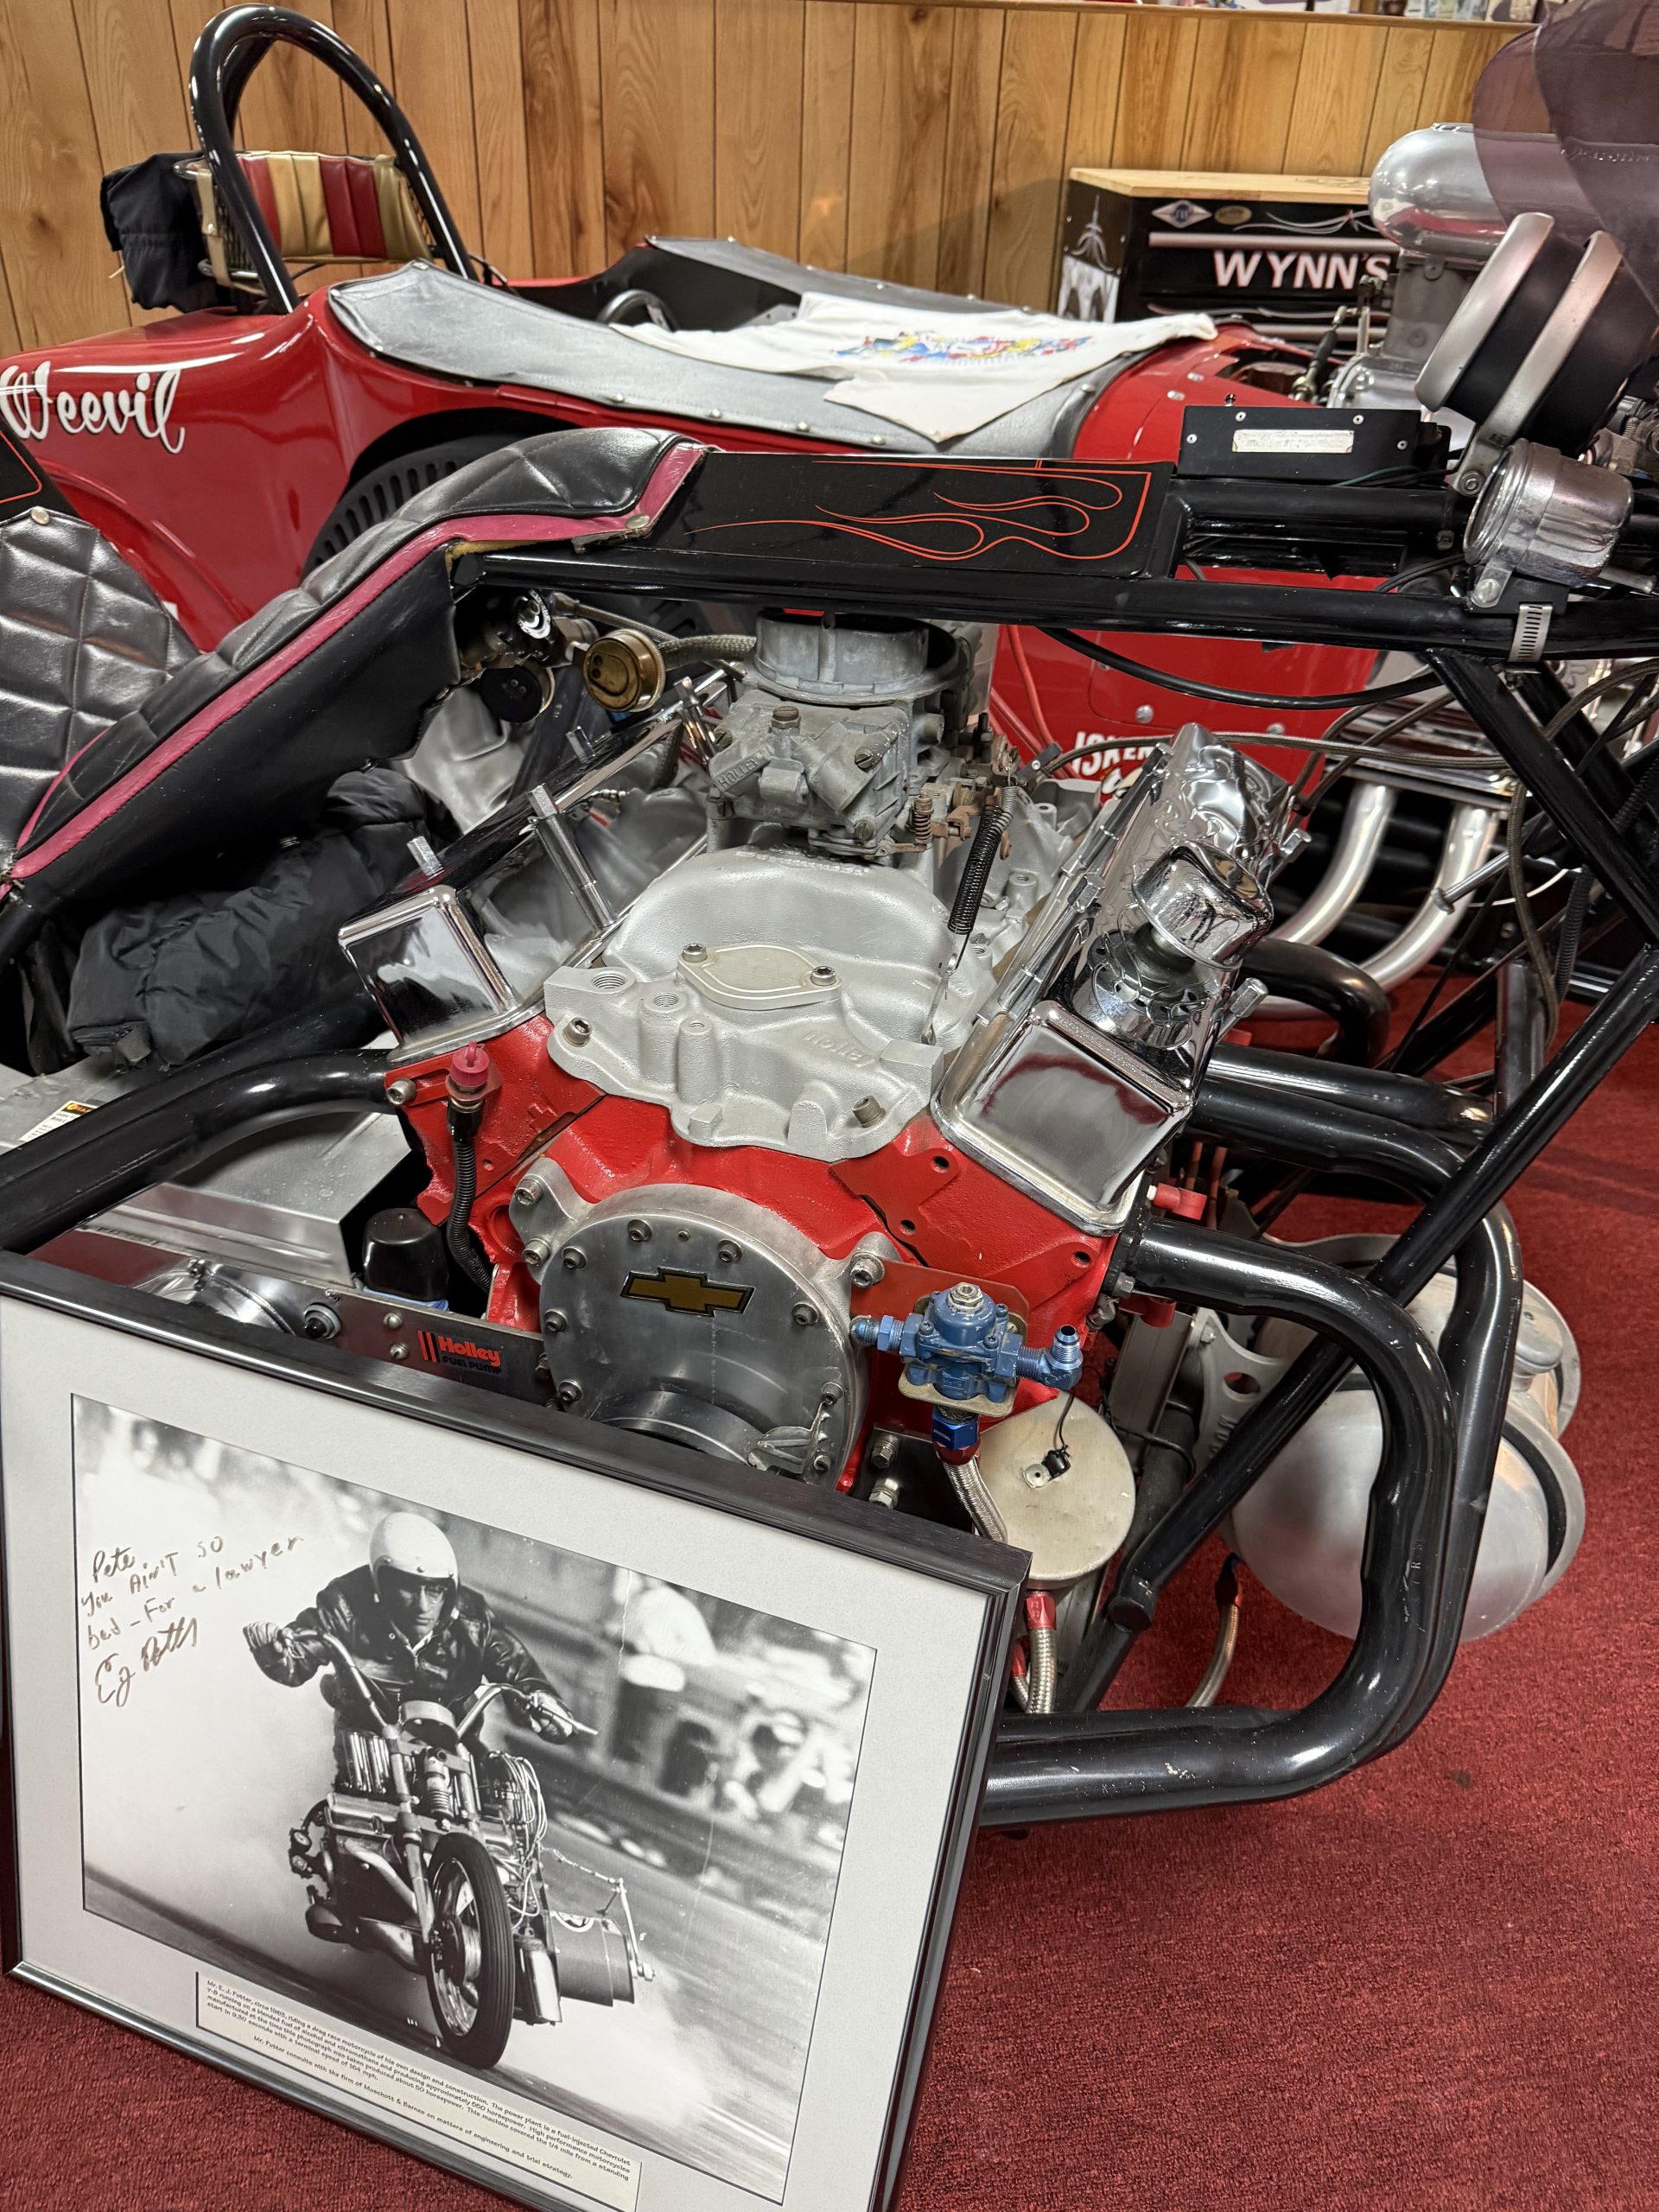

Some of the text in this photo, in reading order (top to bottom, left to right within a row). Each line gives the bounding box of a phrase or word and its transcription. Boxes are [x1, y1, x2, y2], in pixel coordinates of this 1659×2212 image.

[1213, 250, 1392, 289] WYNN'S
[0, 360, 186, 454] Weevil
[717, 758, 760, 791] HOLLEY
[437, 1335, 501, 1367] Holley
[207, 2002, 223, 2012] start
[247, 2019, 274, 2034] seconds
[274, 2031, 288, 2040] with
[294, 2039, 321, 2055] terminal
[321, 2052, 340, 2063] speed
[207, 1995, 249, 2017] manufactured
[257, 2016, 268, 2024] the
[269, 2020, 283, 2031] time
[283, 2027, 296, 2037] this
[296, 2033, 333, 2053] photograph
[333, 2050, 346, 2059] was
[346, 2055, 365, 2067] taken
[365, 2063, 395, 2080] produced
[395, 2076, 415, 2088] about
[467, 2106, 481, 2117] This
[481, 2113, 510, 2129] machine
[509, 2126, 535, 2140] covered
[536, 2136, 548, 2145] the
[560, 2147, 575, 2157] mile
[575, 2152, 592, 2164] from
[598, 2164, 629, 2182] standing
[219, 1993, 242, 2008] running
[257, 2008, 281, 2023] blended
[281, 2018, 293, 2029] fuel
[301, 2029, 324, 2042] alcohol
[323, 2038, 336, 2048] and
[379, 2063, 393, 2072] and
[393, 2069, 425, 2087] producing
[425, 2082, 471, 2107] approximately
[471, 2101, 486, 2112] 550
[529, 2126, 545, 2138] High
[545, 2134, 588, 2156] performance
[588, 2152, 631, 2174] motorcycles
[254, 2001, 270, 2012] circa
[288, 2015, 306, 2029] riding
[311, 2025, 327, 2037] drag
[327, 2032, 341, 2043] race
[341, 2039, 377, 2057] motorcycle
[385, 2056, 395, 2066] his
[395, 2063, 409, 2072] own
[409, 2068, 431, 2082] design
[431, 2078, 444, 2087] and
[491, 2101, 504, 2112] The
[504, 2109, 524, 2120] power
[524, 2117, 543, 2128] plant
[599, 2148, 632, 2166] Chevrolet
[265, 2040, 285, 2053] Potter
[286, 2050, 314, 2066] consults
[314, 2063, 327, 2073] with
[328, 2069, 340, 2078] the
[340, 2074, 354, 2085] firm
[403, 2101, 426, 2115] Barnes
[436, 2117, 464, 2132] matters
[473, 2133, 510, 2153] engineering
[511, 2149, 525, 2158] and
[526, 2154, 541, 2164] trial
